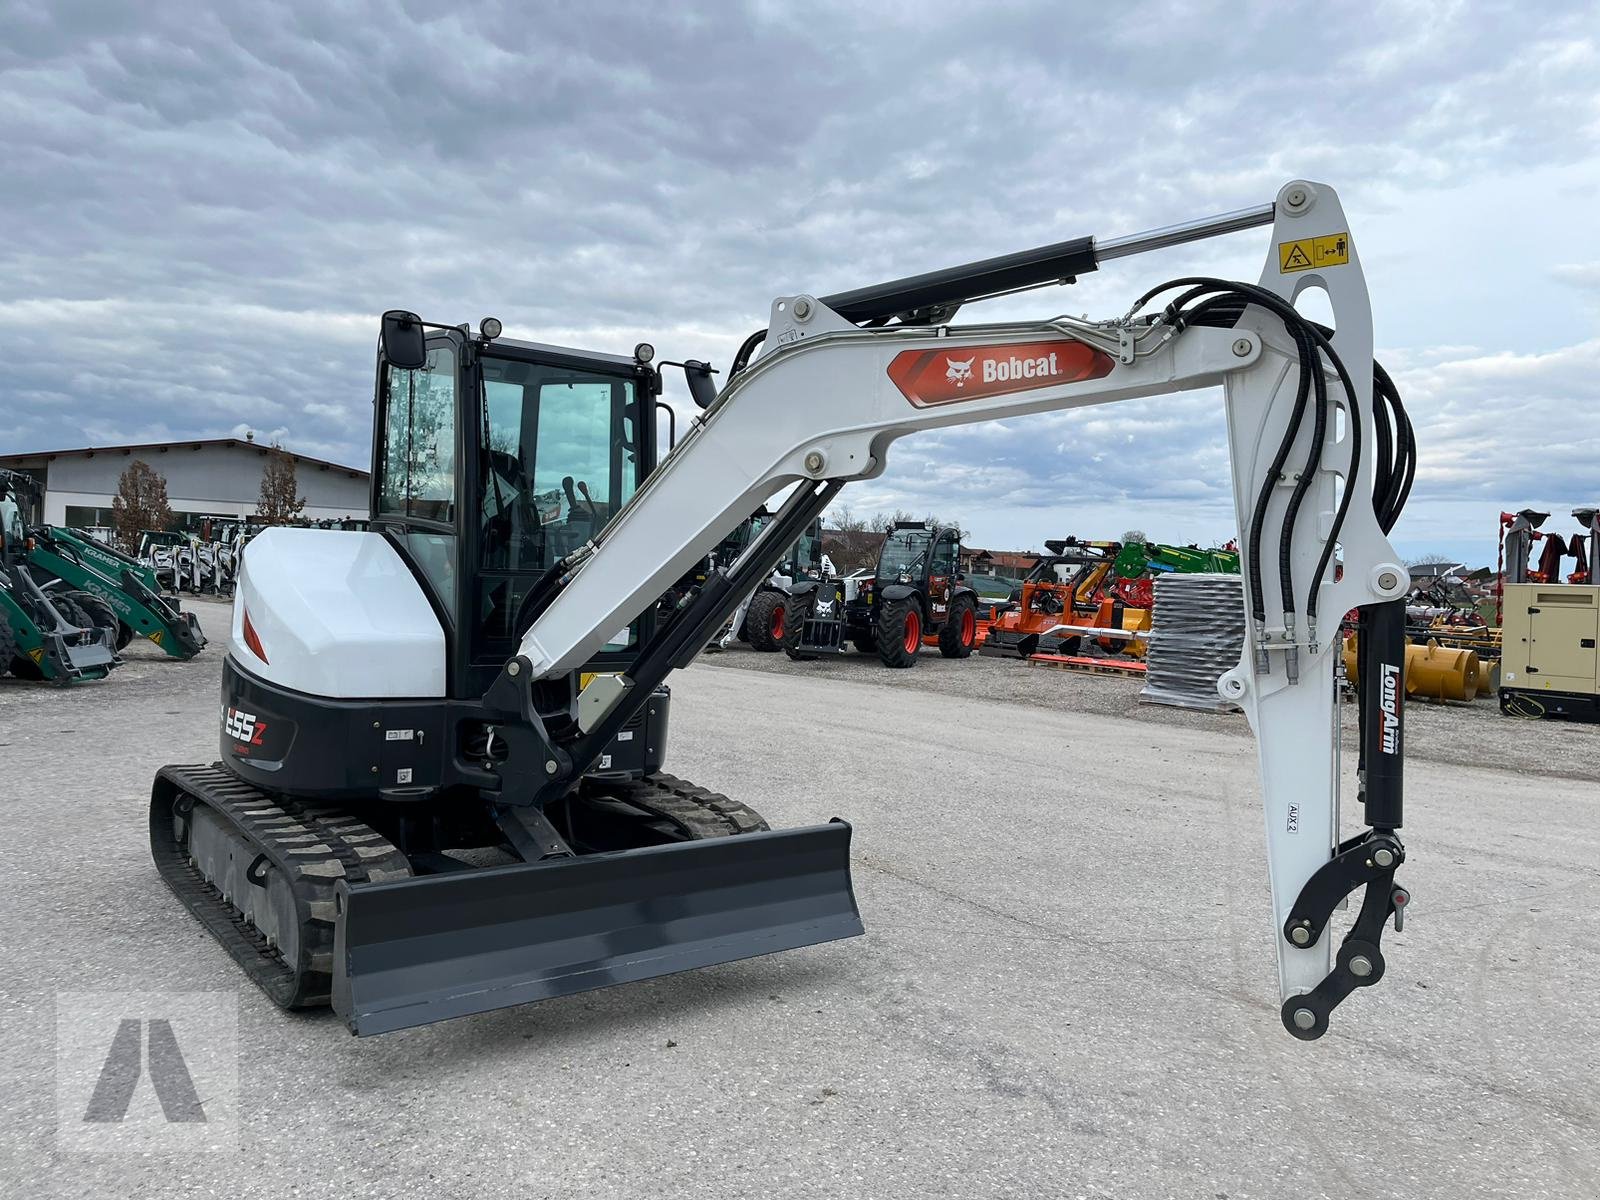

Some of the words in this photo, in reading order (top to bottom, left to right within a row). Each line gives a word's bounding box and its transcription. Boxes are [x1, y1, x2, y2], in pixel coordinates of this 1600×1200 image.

[983, 352, 1058, 383] Bobcat
[83, 547, 120, 569] KRAMER
[83, 580, 132, 615] KRAMER
[1380, 663, 1400, 755] LongArm
[1289, 805, 1298, 824] AUX
